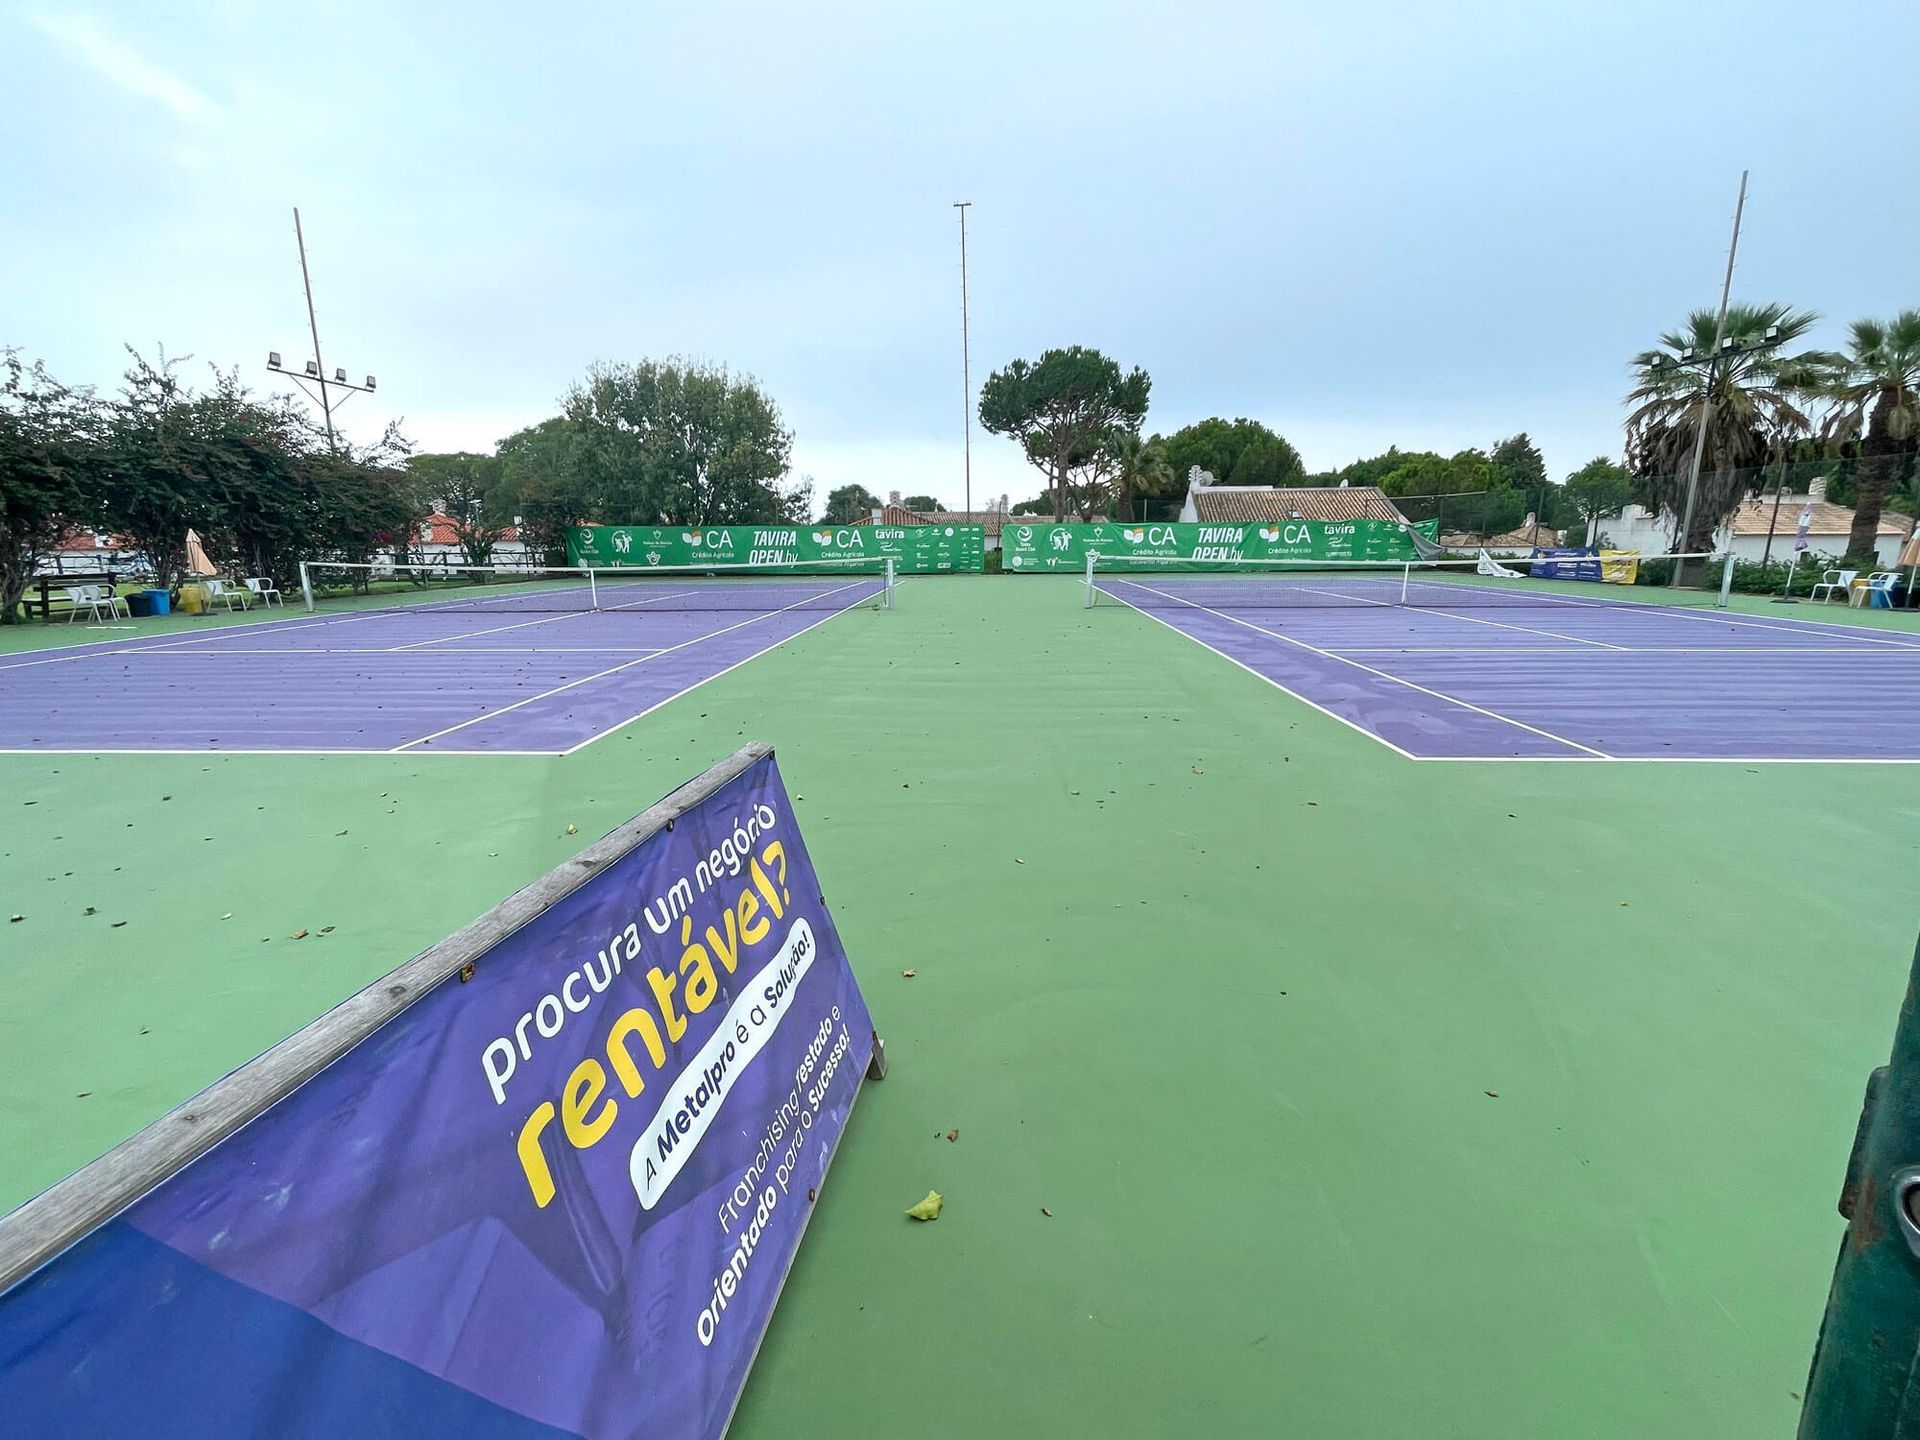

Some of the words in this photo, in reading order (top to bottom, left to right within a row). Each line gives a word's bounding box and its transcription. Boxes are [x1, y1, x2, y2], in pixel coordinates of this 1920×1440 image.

[706, 529, 734, 549] CA
[753, 530, 797, 546] TAVIRA
[836, 529, 864, 548] CA
[875, 529, 905, 539] tavira
[1148, 526, 1177, 546] CA
[1198, 527, 1243, 543] TAVIRA
[1283, 524, 1312, 544] CA
[1324, 523, 1355, 535] tavira
[749, 549, 784, 565] OPEN
[1192, 546, 1229, 561] OPEN
[480, 921, 641, 1106] procura
[643, 877, 694, 935] um
[696, 803, 777, 895] negócio
[516, 839, 788, 1209] rentável?
[644, 1157, 658, 1191] A
[656, 1039, 736, 1163] Metalpro
[735, 1018, 749, 1044] é
[750, 1004, 768, 1026] a
[764, 930, 810, 1009] Solução!
[718, 1084, 800, 1234] Franchising
[831, 1005, 841, 1021] e
[697, 1184, 778, 1347] Orientado
[774, 1126, 804, 1195] para
[801, 1109, 814, 1130] o
[808, 1022, 850, 1112] sucesso!
